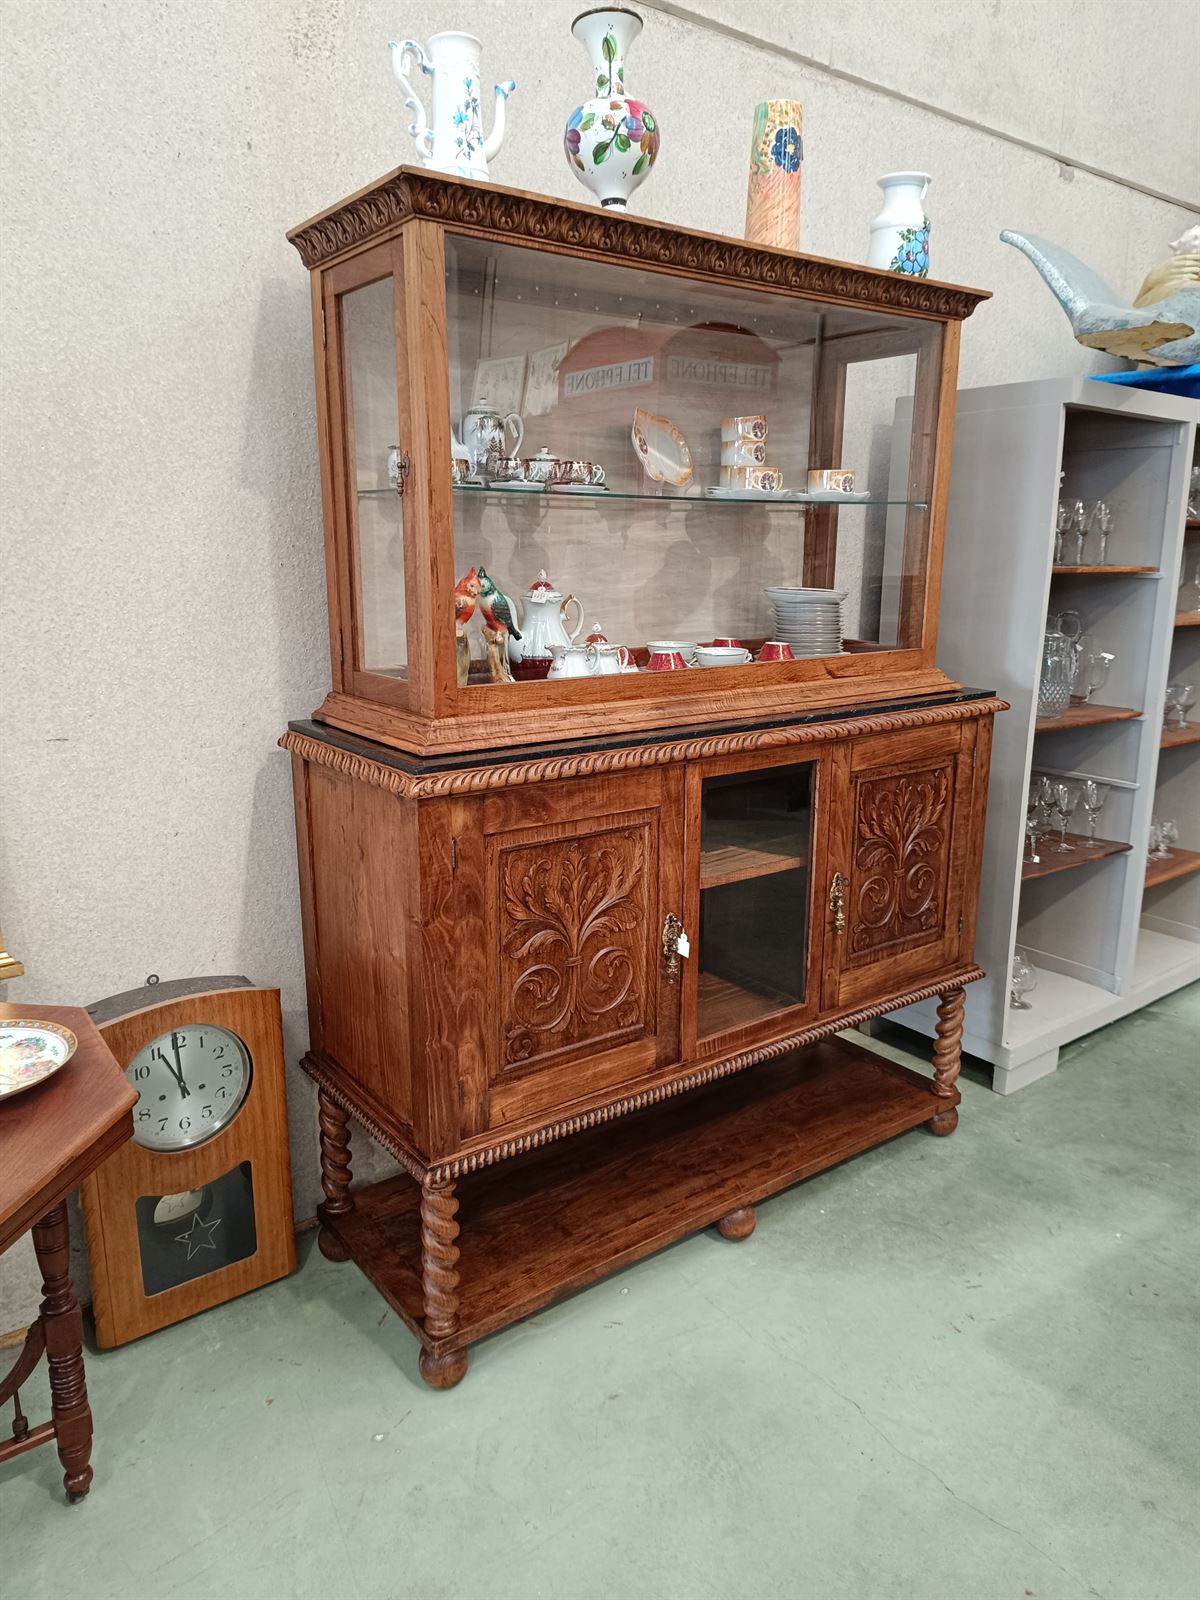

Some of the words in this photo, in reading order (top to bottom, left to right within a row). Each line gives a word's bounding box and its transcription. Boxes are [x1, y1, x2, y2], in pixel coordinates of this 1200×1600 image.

[200, 1035, 204, 1049] 1
[151, 1046, 161, 1061] 11
[212, 1046, 225, 1060] 2
[134, 1065, 151, 1081] 10
[214, 1086, 226, 1099] 4
[138, 1107, 151, 1122] 8
[201, 1104, 213, 1119] 5
[158, 1117, 169, 1132] 7
[178, 1116, 191, 1130] 6
